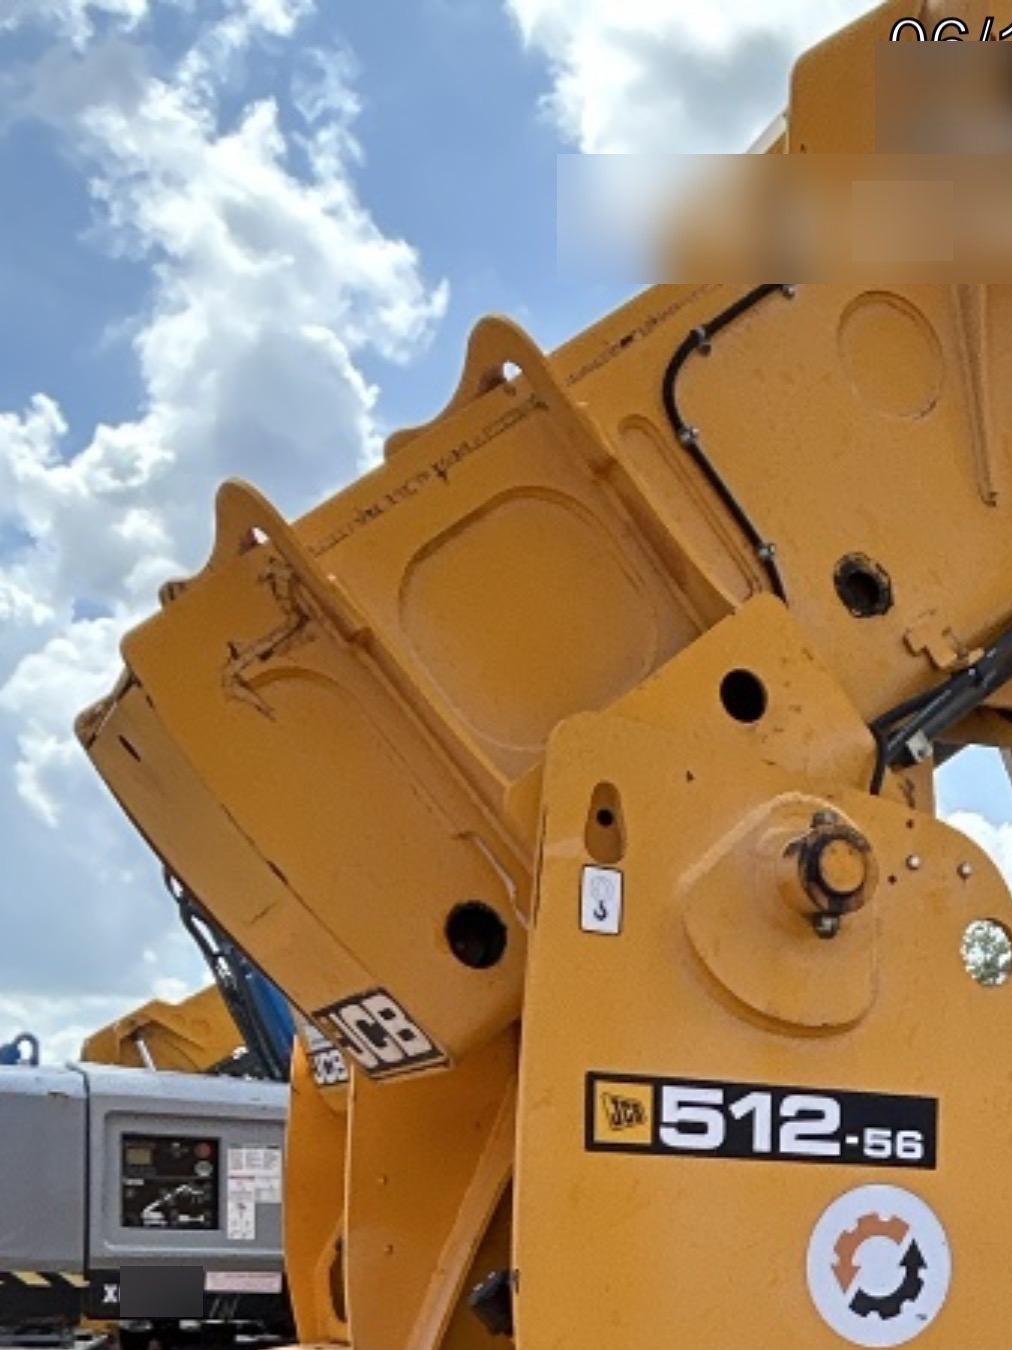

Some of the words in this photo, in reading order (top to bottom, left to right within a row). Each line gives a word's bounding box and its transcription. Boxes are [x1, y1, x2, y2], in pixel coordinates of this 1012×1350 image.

[330, 994, 433, 1069] JCB
[604, 1093, 648, 1130] JCB
[659, 1085, 925, 1159] 512-56
